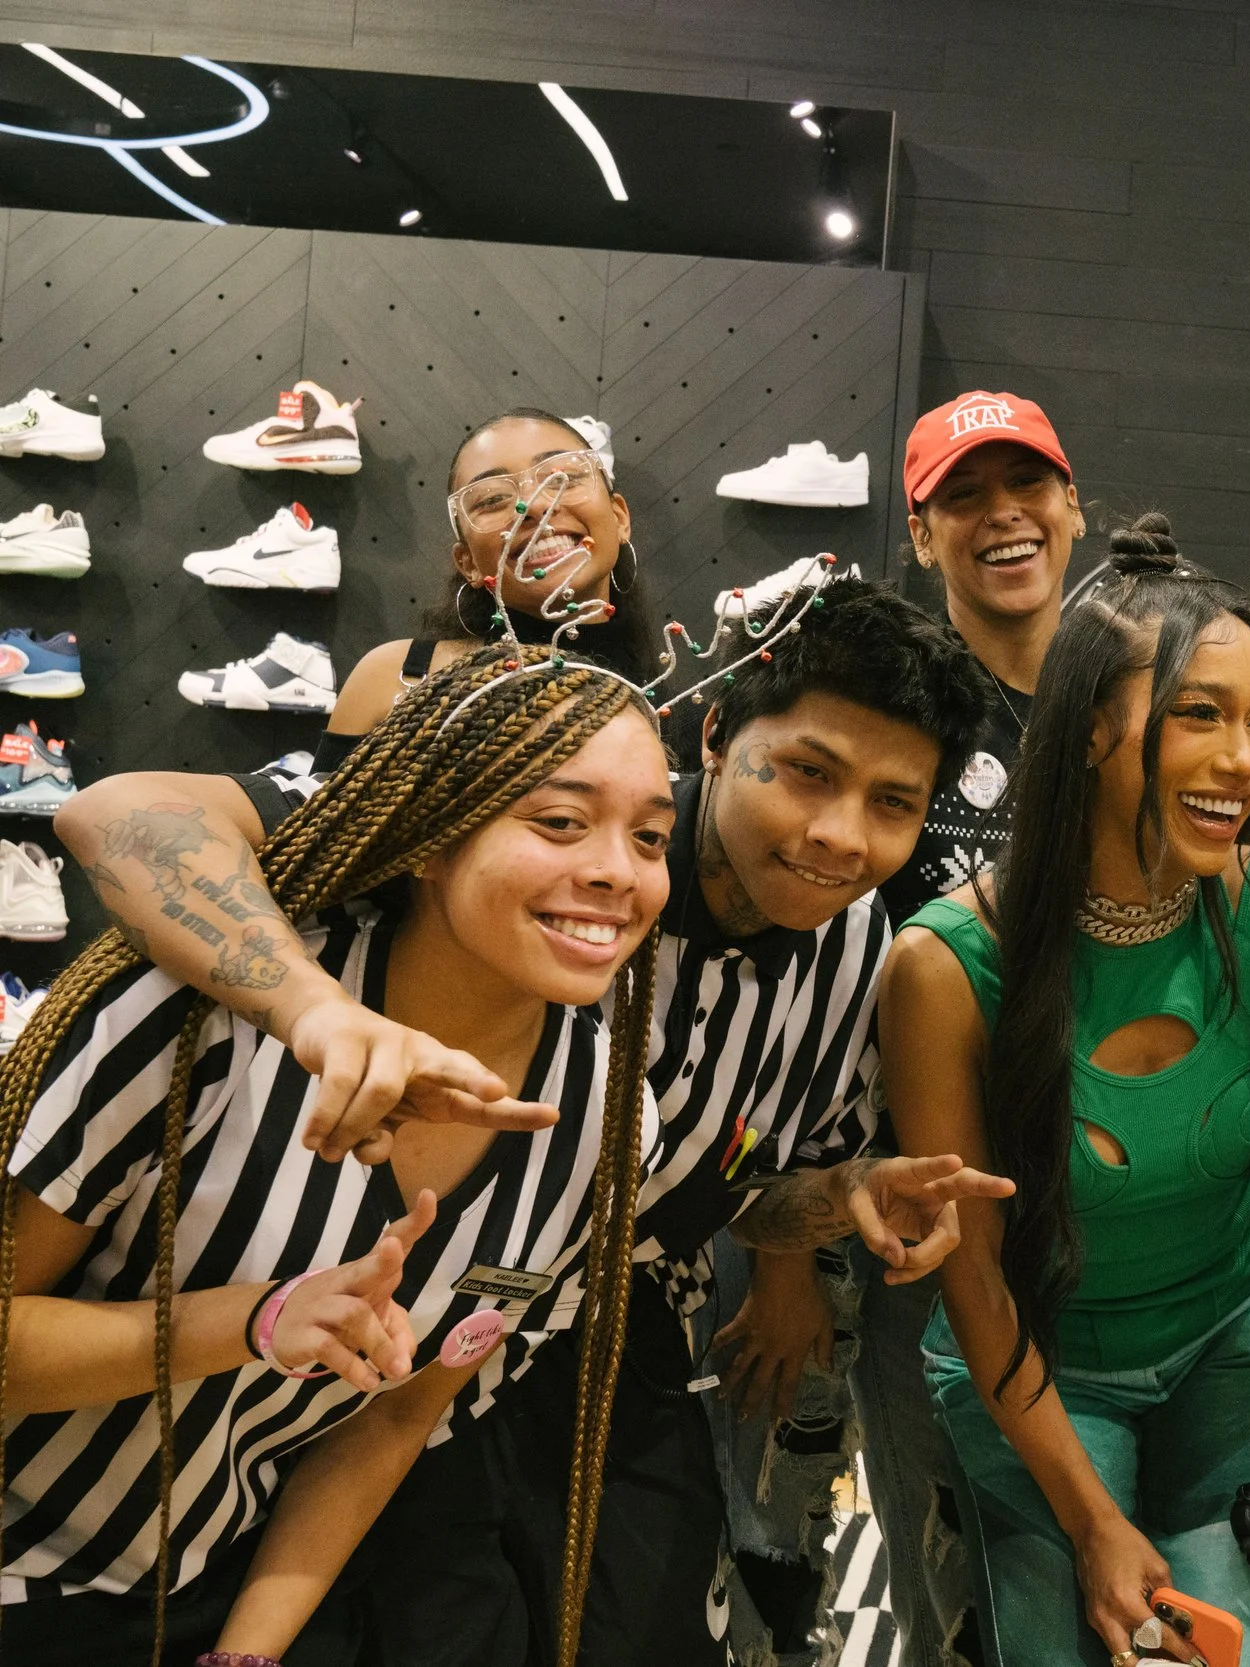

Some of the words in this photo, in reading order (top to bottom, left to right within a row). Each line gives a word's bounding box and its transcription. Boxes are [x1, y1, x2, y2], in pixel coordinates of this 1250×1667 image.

[949, 404, 1013, 437] TRAP
[462, 1280, 483, 1290] Kids
[483, 1283, 504, 1294] Foot
[503, 1287, 533, 1299] Locker
[461, 1330, 486, 1346] Fight
[469, 1342, 488, 1357] girl
